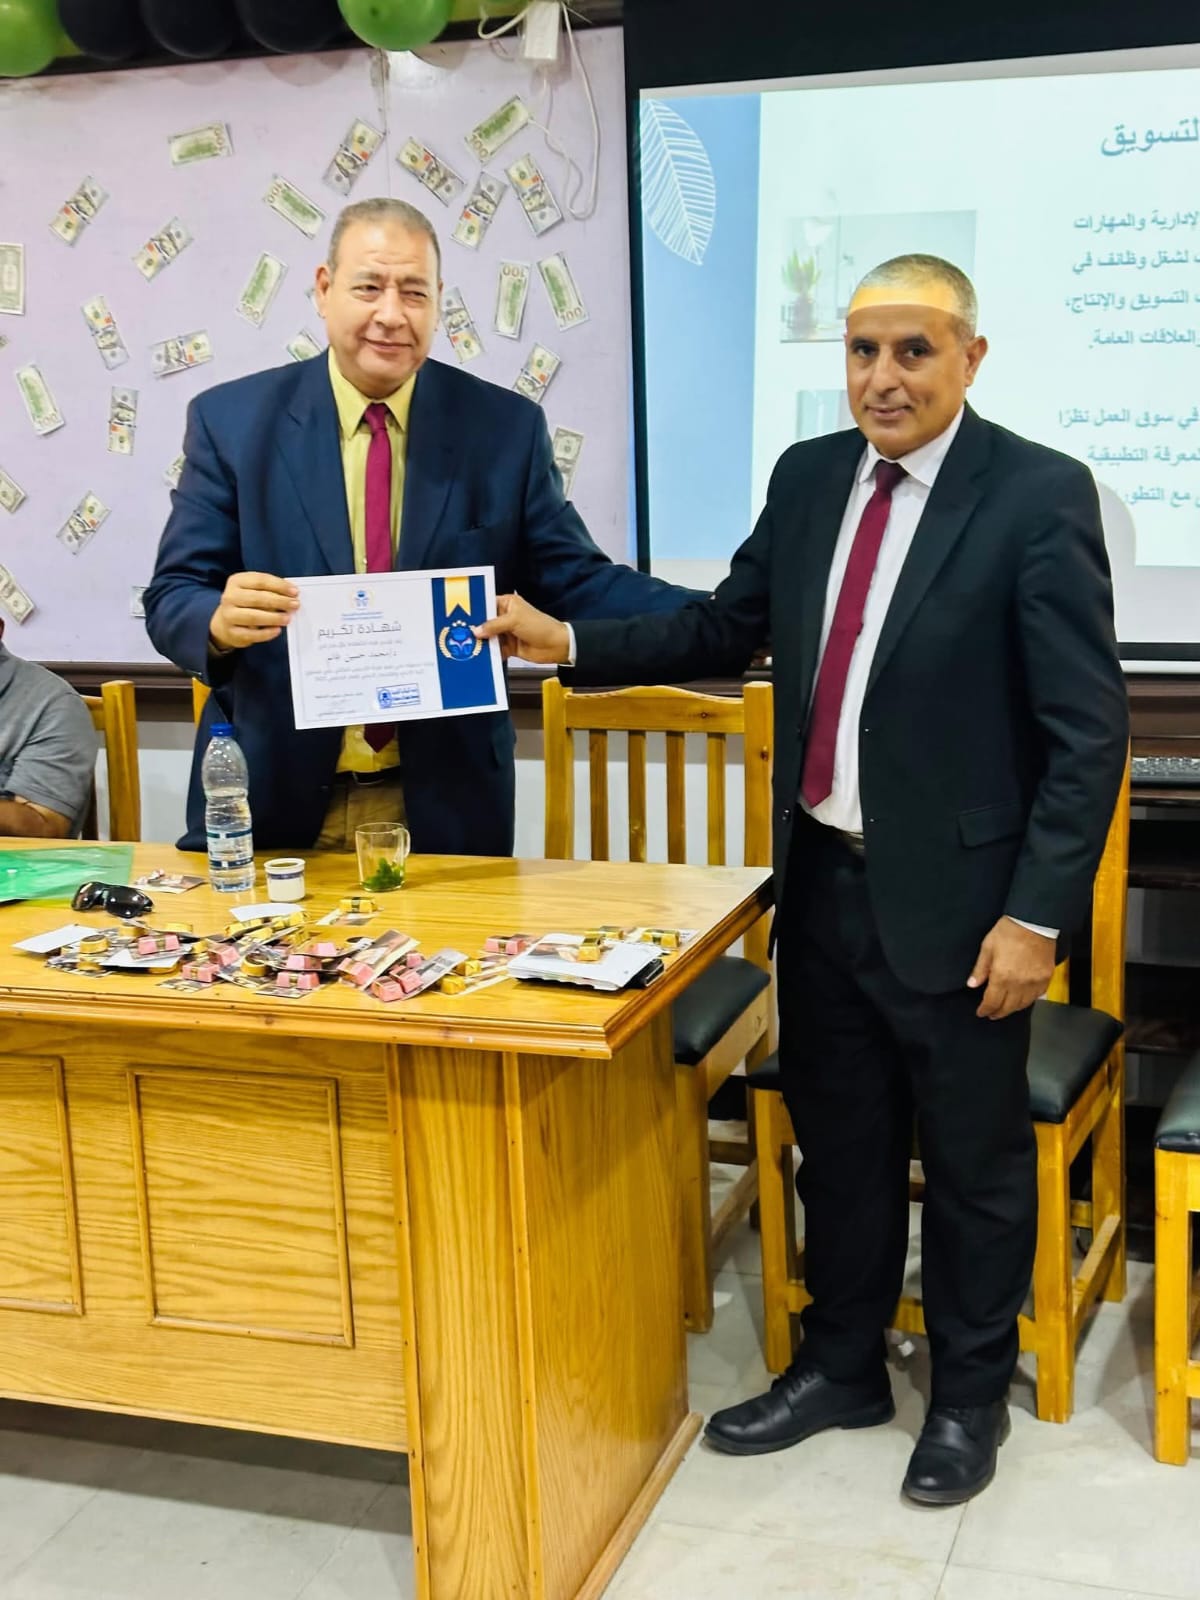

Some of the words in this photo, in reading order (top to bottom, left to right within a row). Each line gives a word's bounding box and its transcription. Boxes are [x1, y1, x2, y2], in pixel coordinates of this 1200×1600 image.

[1074, 212, 1146, 233] والمهارات
[1072, 251, 1093, 275] في
[1098, 250, 1146, 269] وظائف
[1151, 250, 1188, 268] لشغل
[503, 265, 526, 278] 100
[1131, 289, 1190, 311] التسويق
[560, 306, 583, 324] 100
[1094, 408, 1131, 427] العمل
[1135, 411, 1174, 428] سوق
[1178, 406, 1200, 430] في
[1088, 445, 1148, 466] التطبيقية
[1170, 490, 1191, 508] مع
